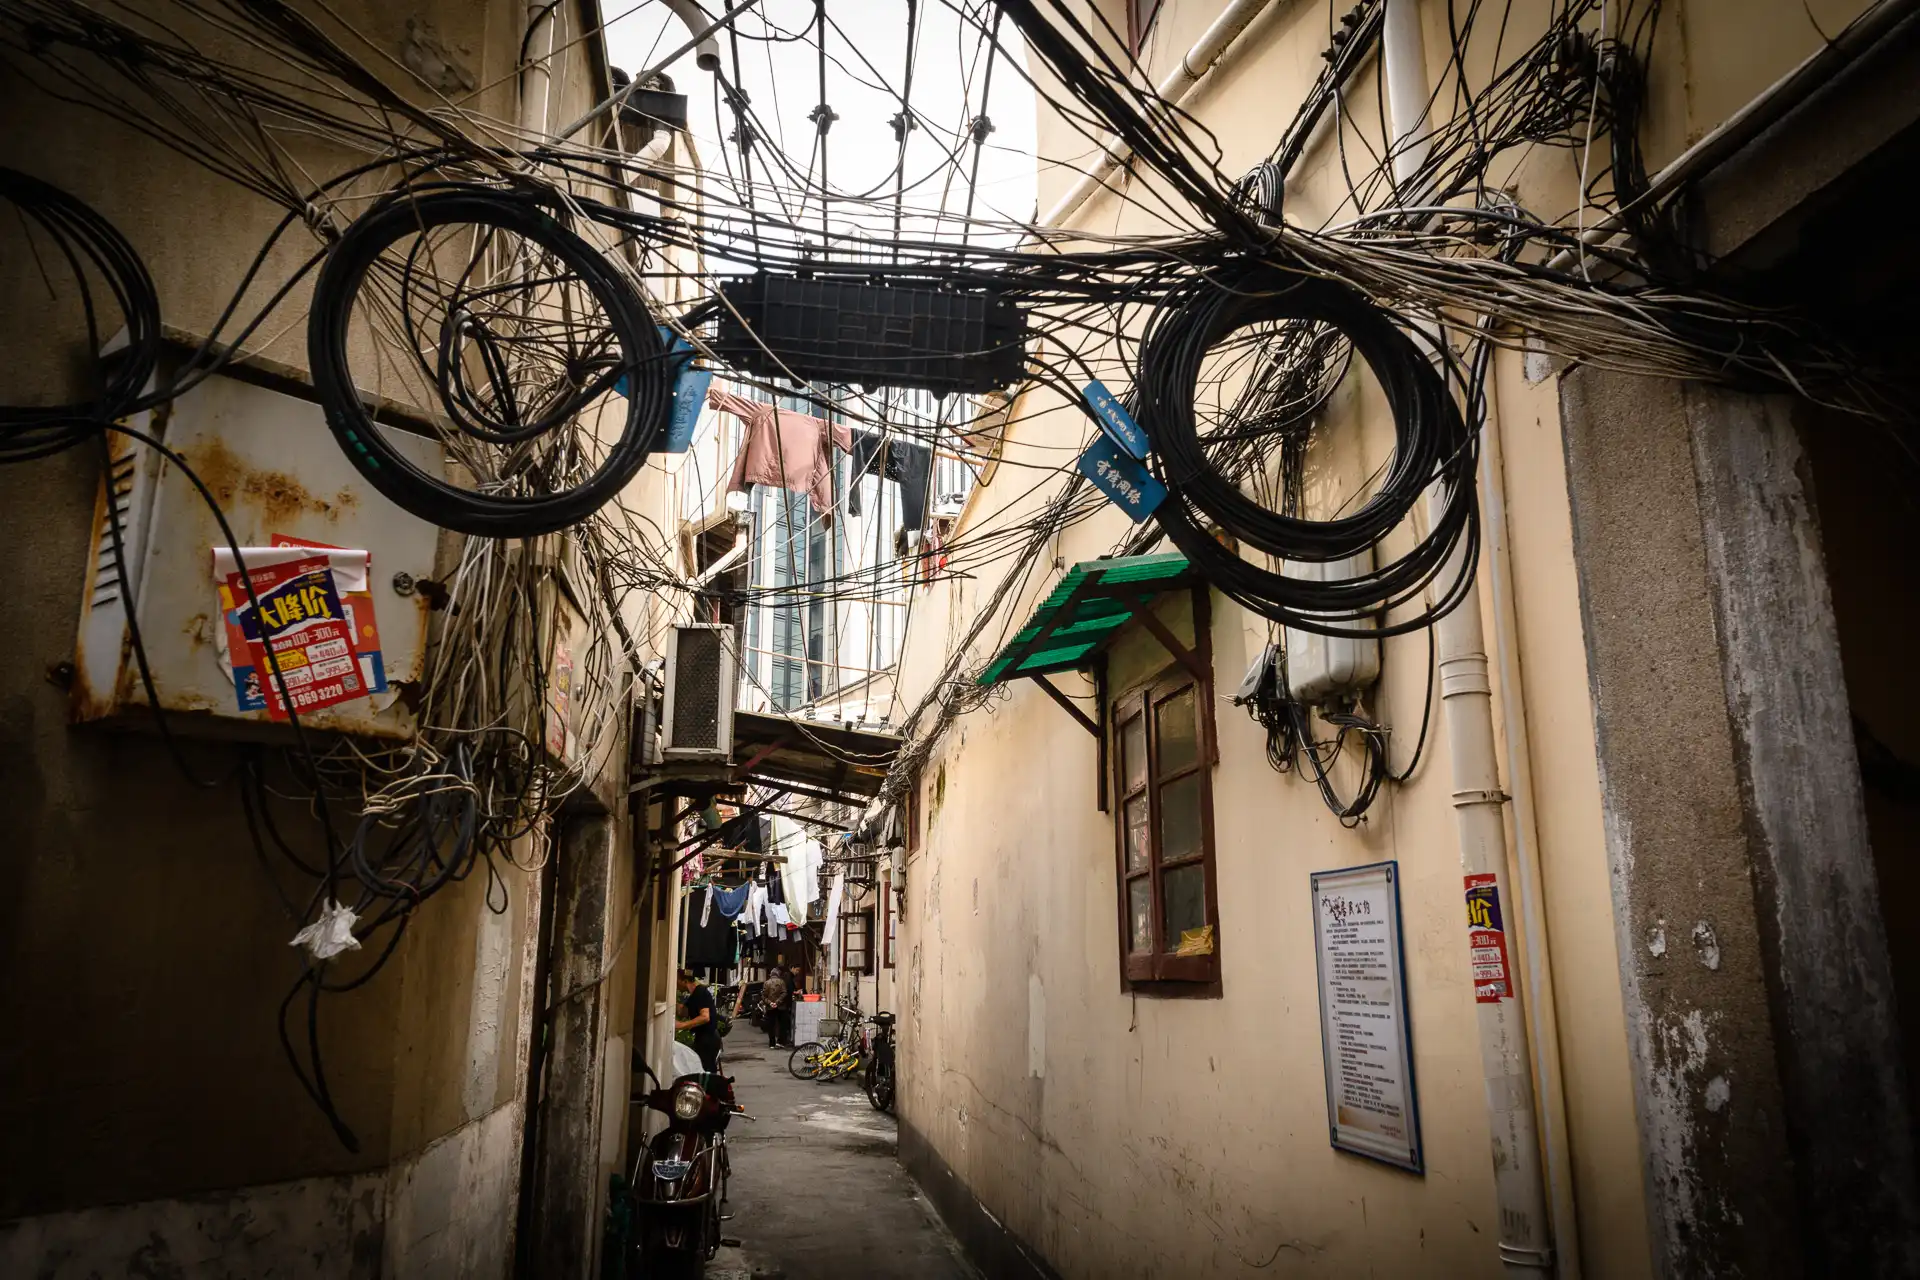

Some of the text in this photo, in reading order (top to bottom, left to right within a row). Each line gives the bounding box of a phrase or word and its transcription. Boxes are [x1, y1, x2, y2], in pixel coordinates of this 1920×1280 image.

[1096, 460, 1141, 504] 有线网络
[254, 585, 333, 630] 大降价
[299, 690, 318, 707] 969
[319, 683, 344, 701] 3220
